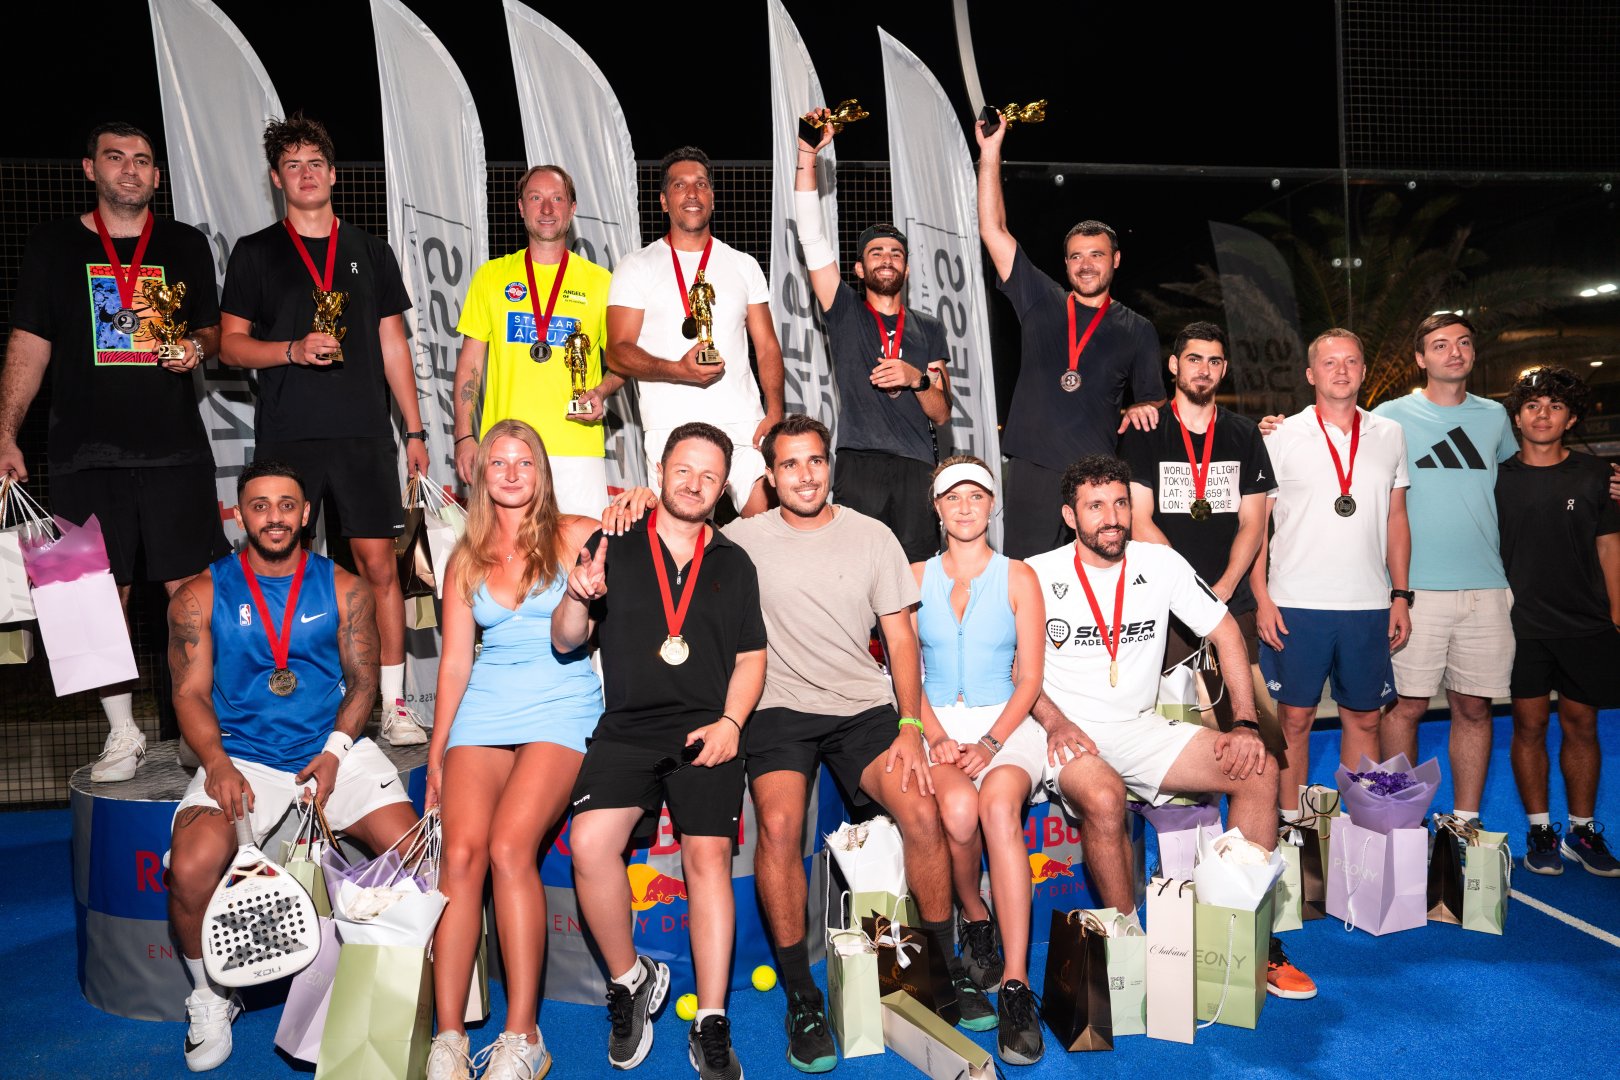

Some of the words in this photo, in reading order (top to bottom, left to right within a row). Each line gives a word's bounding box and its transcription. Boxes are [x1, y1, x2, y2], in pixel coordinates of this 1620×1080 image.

[563, 289, 586, 298] ANGELS
[514, 315, 573, 329] STELAR
[160, 346, 169, 358] 2
[1164, 466, 1191, 476] WORLD
[1210, 465, 1239, 476] FLIGHT
[1163, 488, 1182, 498] LAT:
[1162, 500, 1184, 510] LON:
[1050, 881, 1085, 897] DRIN
[1195, 949, 1247, 969] EONY
